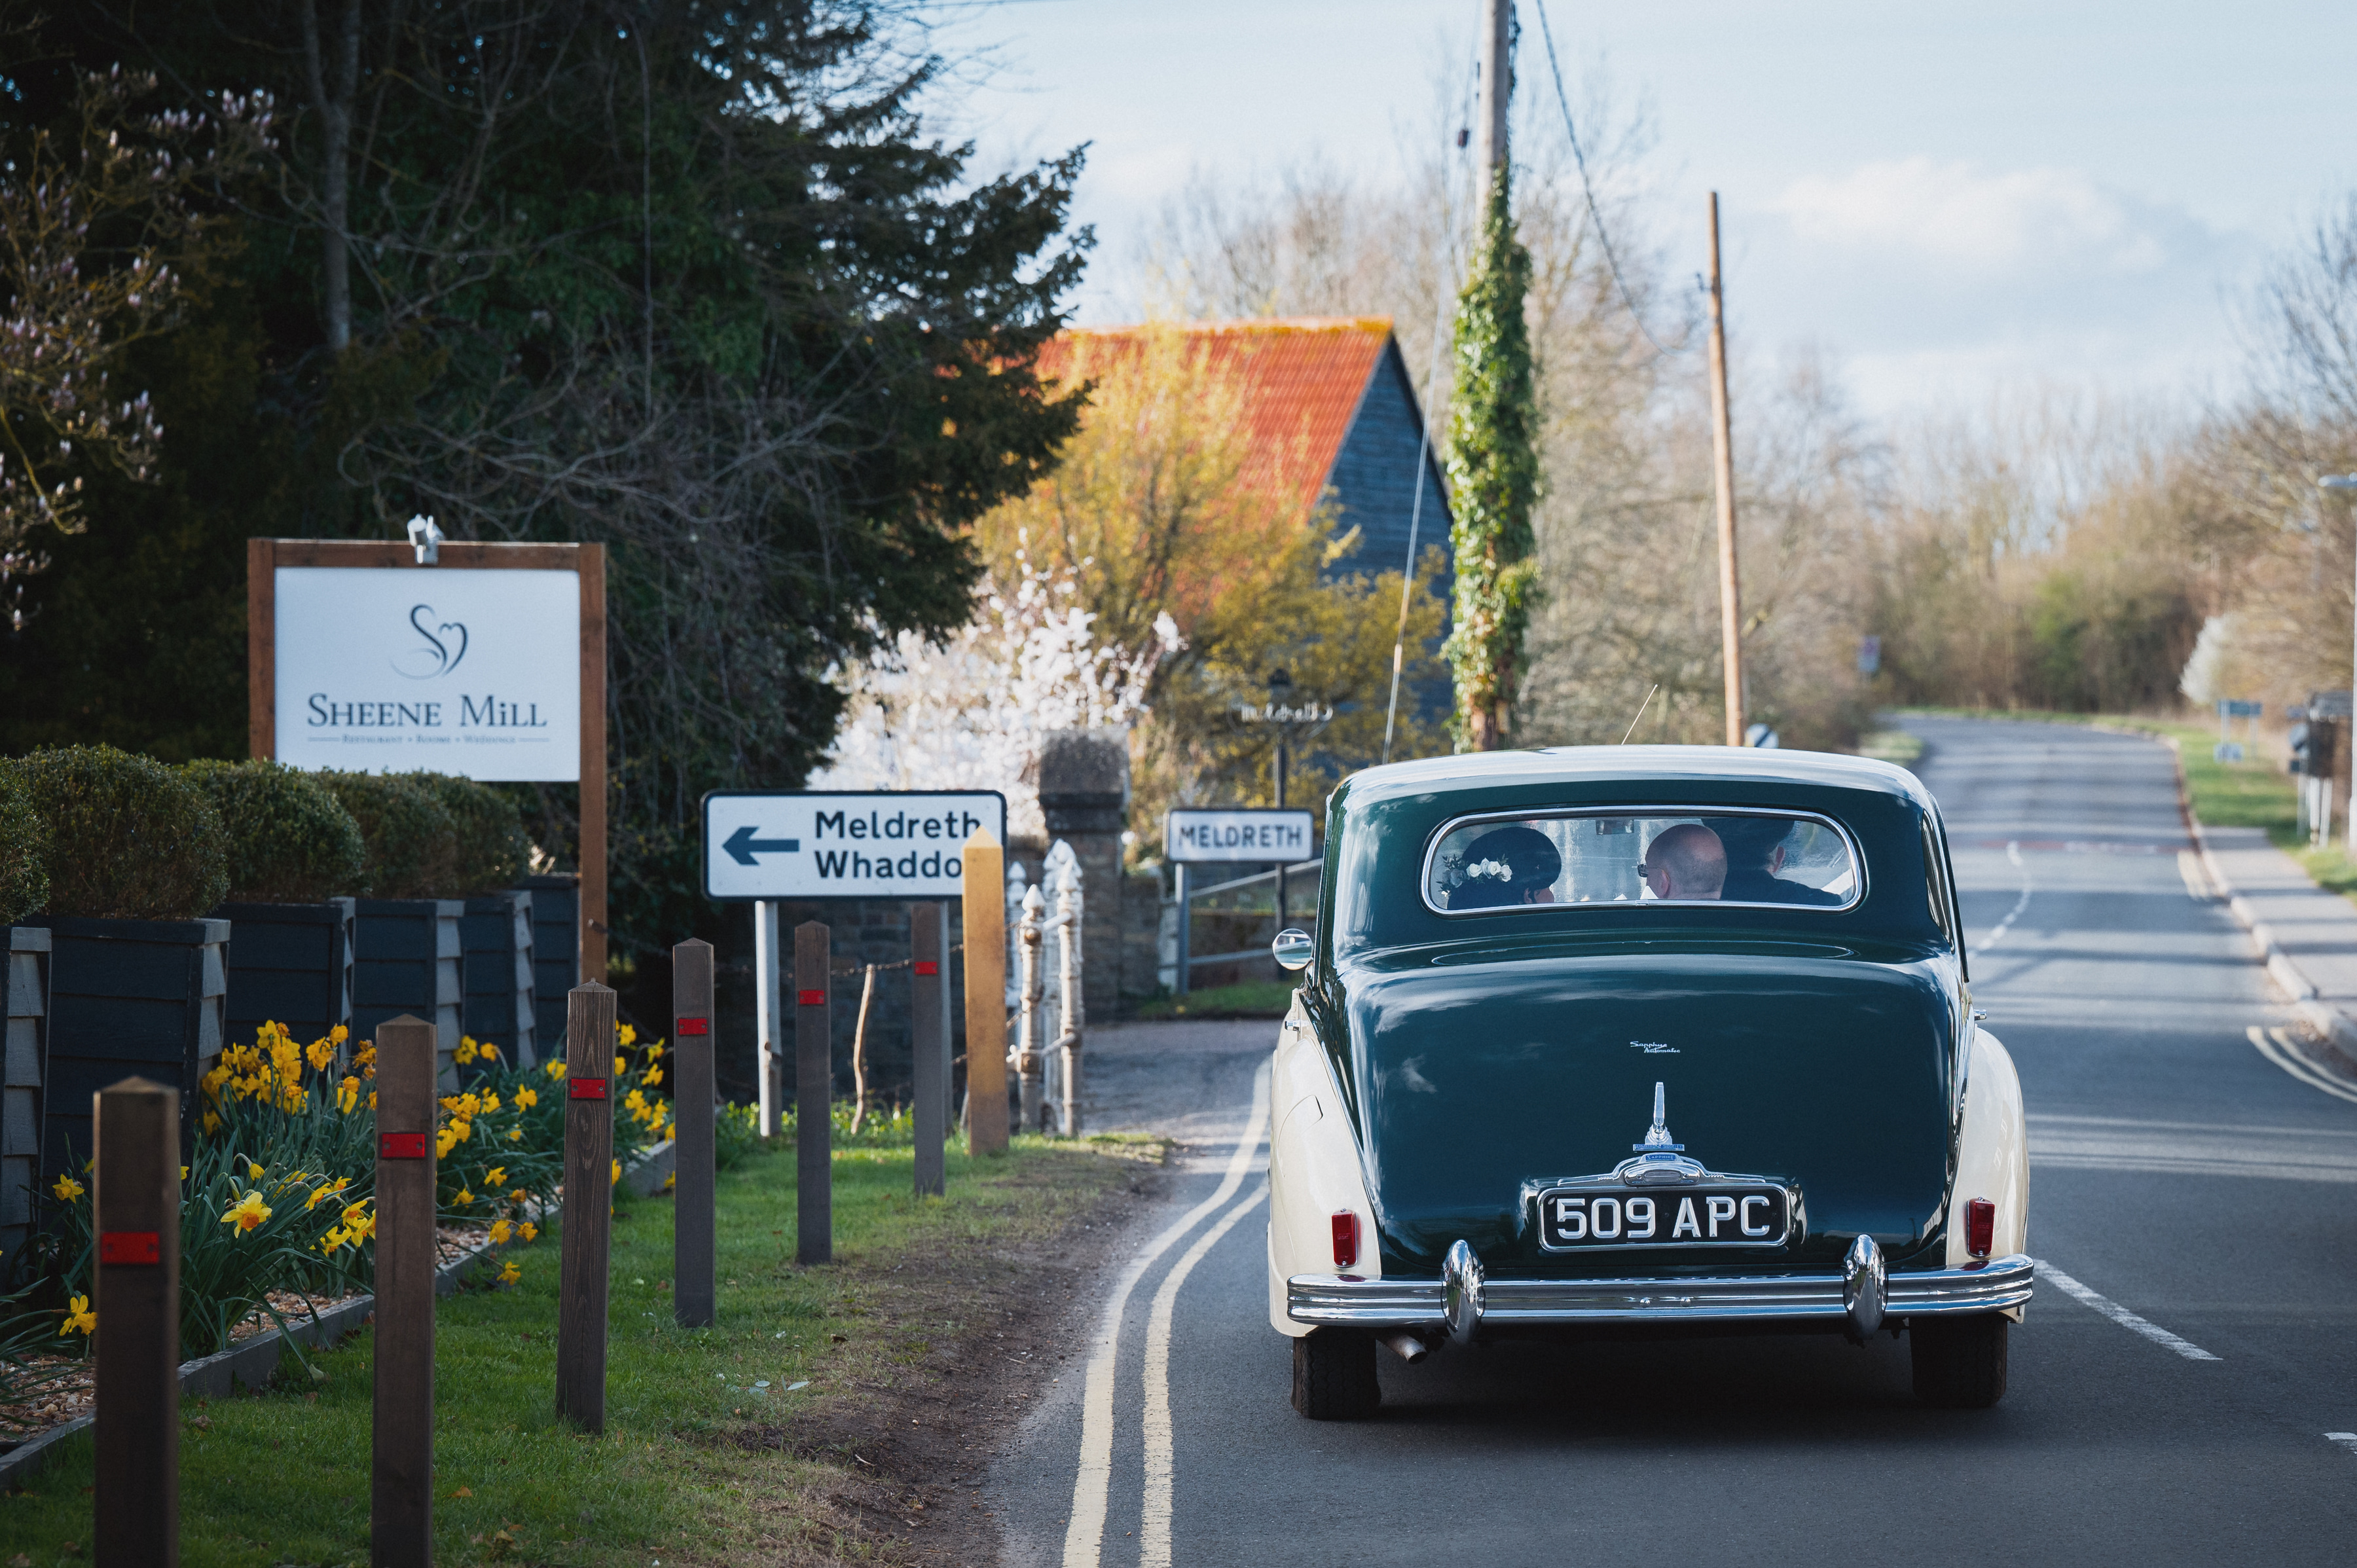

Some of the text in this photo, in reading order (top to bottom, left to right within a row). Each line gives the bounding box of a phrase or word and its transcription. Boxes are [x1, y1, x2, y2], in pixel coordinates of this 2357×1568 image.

[308, 693, 443, 727] SHEENE
[815, 811, 980, 839] Meldreth
[1178, 824, 1303, 848] MELDRETH
[814, 850, 962, 879] Whaddo
[1557, 1195, 1770, 1239] 509 APC
